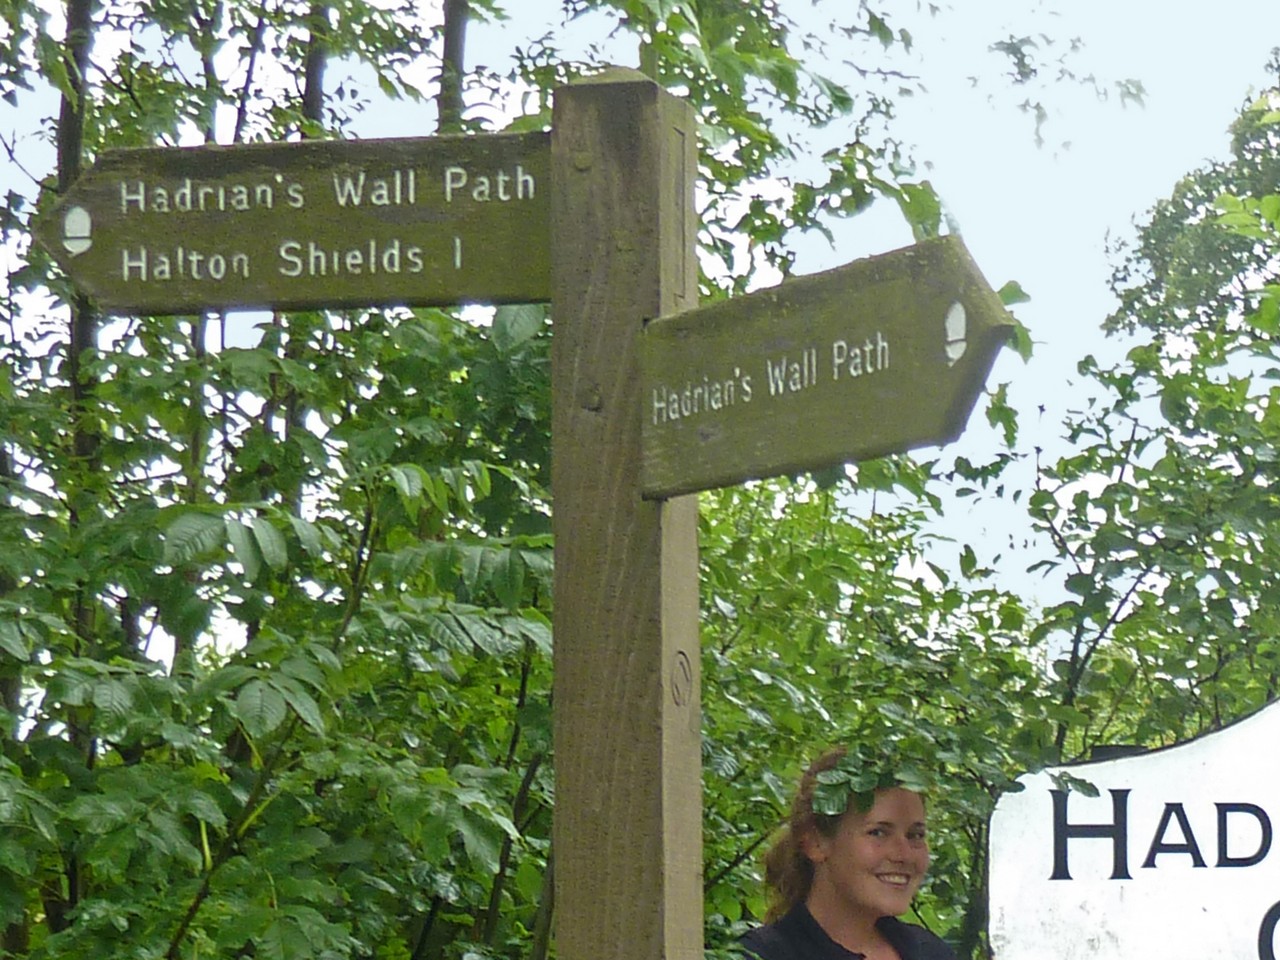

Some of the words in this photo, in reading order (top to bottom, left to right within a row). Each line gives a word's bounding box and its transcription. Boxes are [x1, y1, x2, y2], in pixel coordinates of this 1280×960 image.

[120, 172, 305, 214] Hadrian's
[332, 168, 416, 207] Wall
[444, 165, 536, 203] Path
[122, 245, 250, 282] Halton
[278, 238, 424, 277] Shields
[652, 366, 752, 426] Hadrian's
[766, 348, 817, 397] Wall
[833, 331, 890, 381] Path
